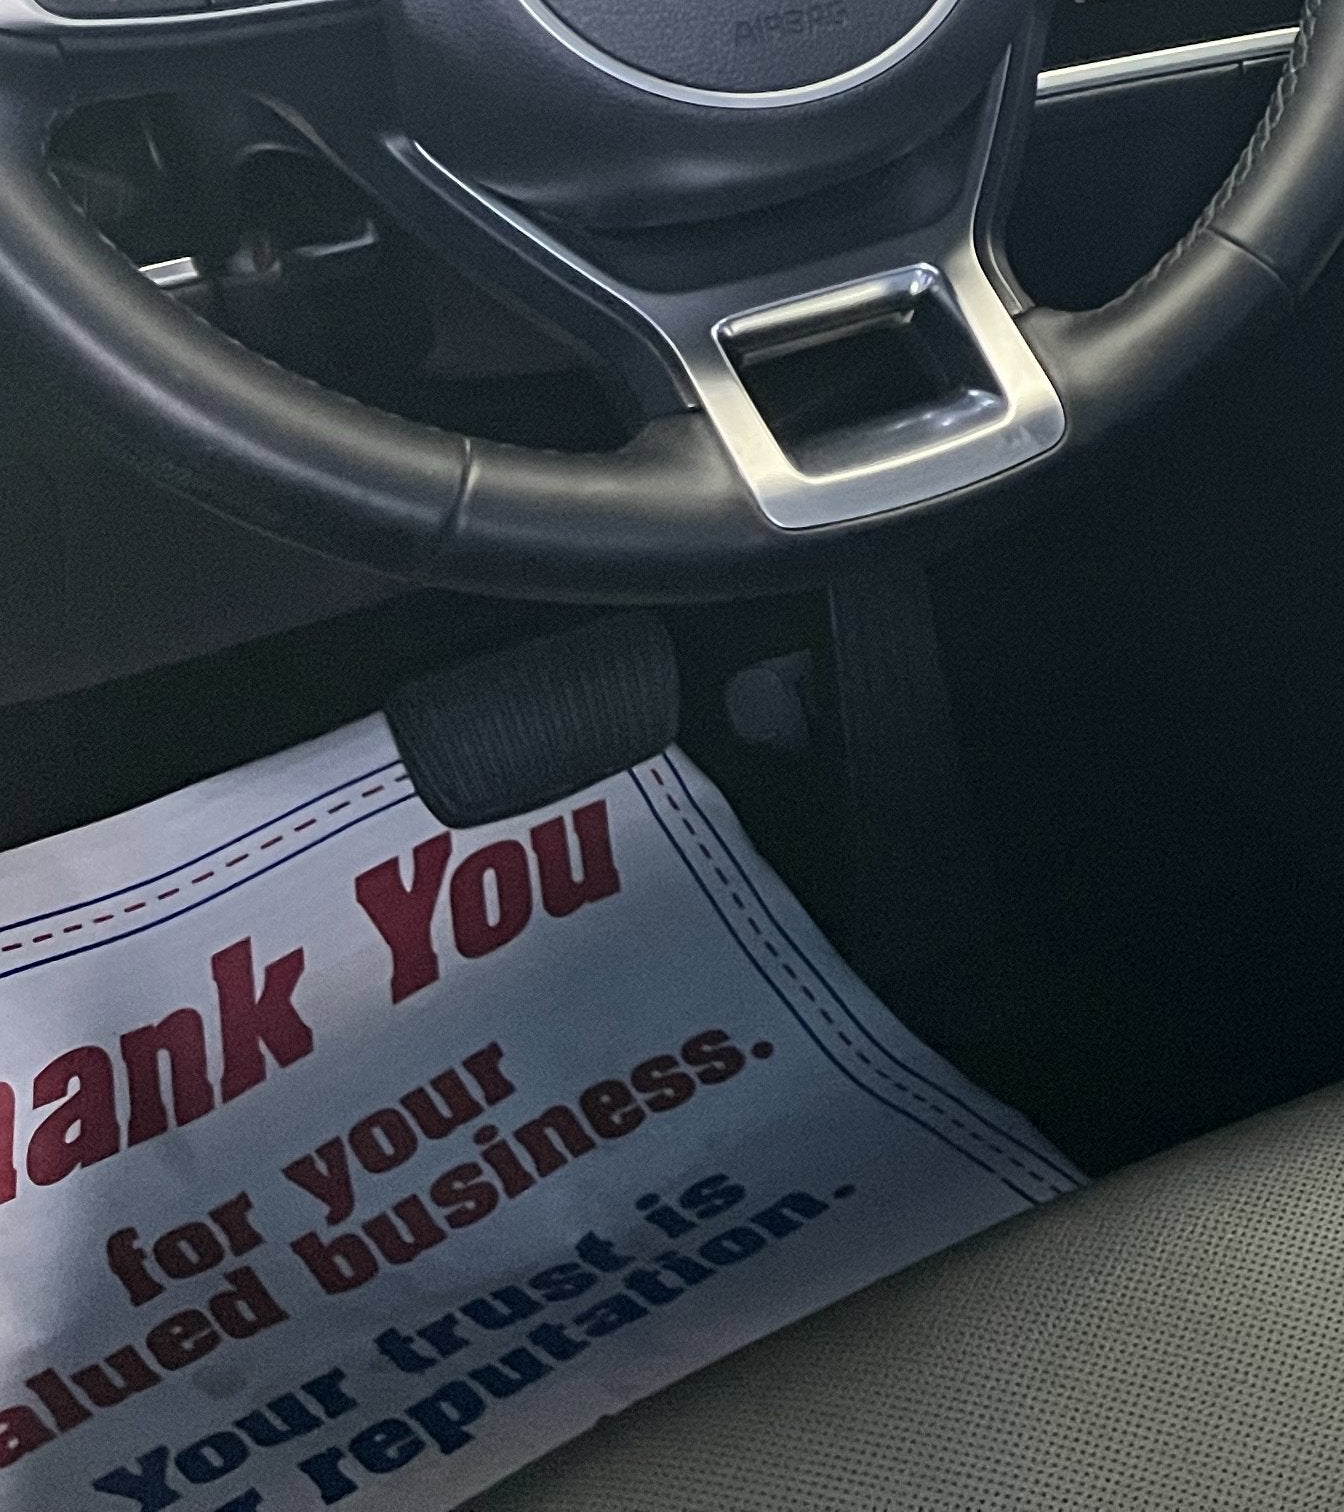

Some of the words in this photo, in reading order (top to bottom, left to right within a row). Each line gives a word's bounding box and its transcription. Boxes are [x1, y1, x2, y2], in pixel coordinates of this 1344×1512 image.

[0, 937, 314, 1206] ank
[356, 799, 621, 1005] You
[291, 1027, 775, 1296] business.
[107, 1193, 264, 1307] for
[283, 1041, 517, 1223] your
[93, 1366, 358, 1512] Your
[374, 1233, 636, 1374] trust
[635, 1170, 747, 1240] is
[297, 1182, 858, 1506] reputation.
